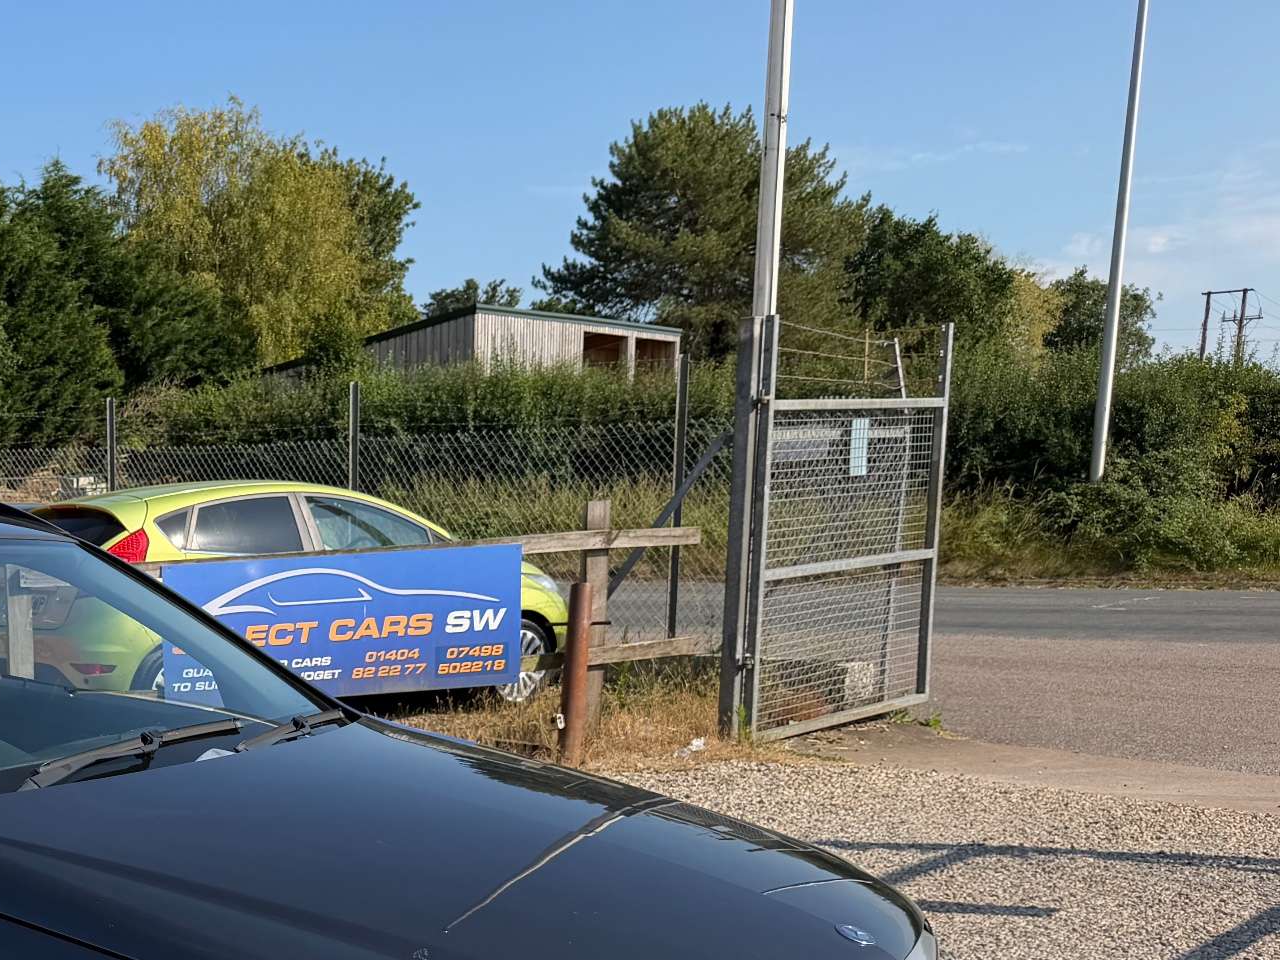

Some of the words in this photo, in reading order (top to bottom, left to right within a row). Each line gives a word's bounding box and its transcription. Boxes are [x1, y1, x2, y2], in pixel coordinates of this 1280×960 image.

[328, 613, 433, 642] CARS
[445, 607, 507, 633] SW
[365, 648, 420, 663] 01404
[446, 644, 504, 660] 07498
[291, 656, 332, 668] CARS
[437, 659, 506, 675] 502218
[172, 683, 192, 692] TO
